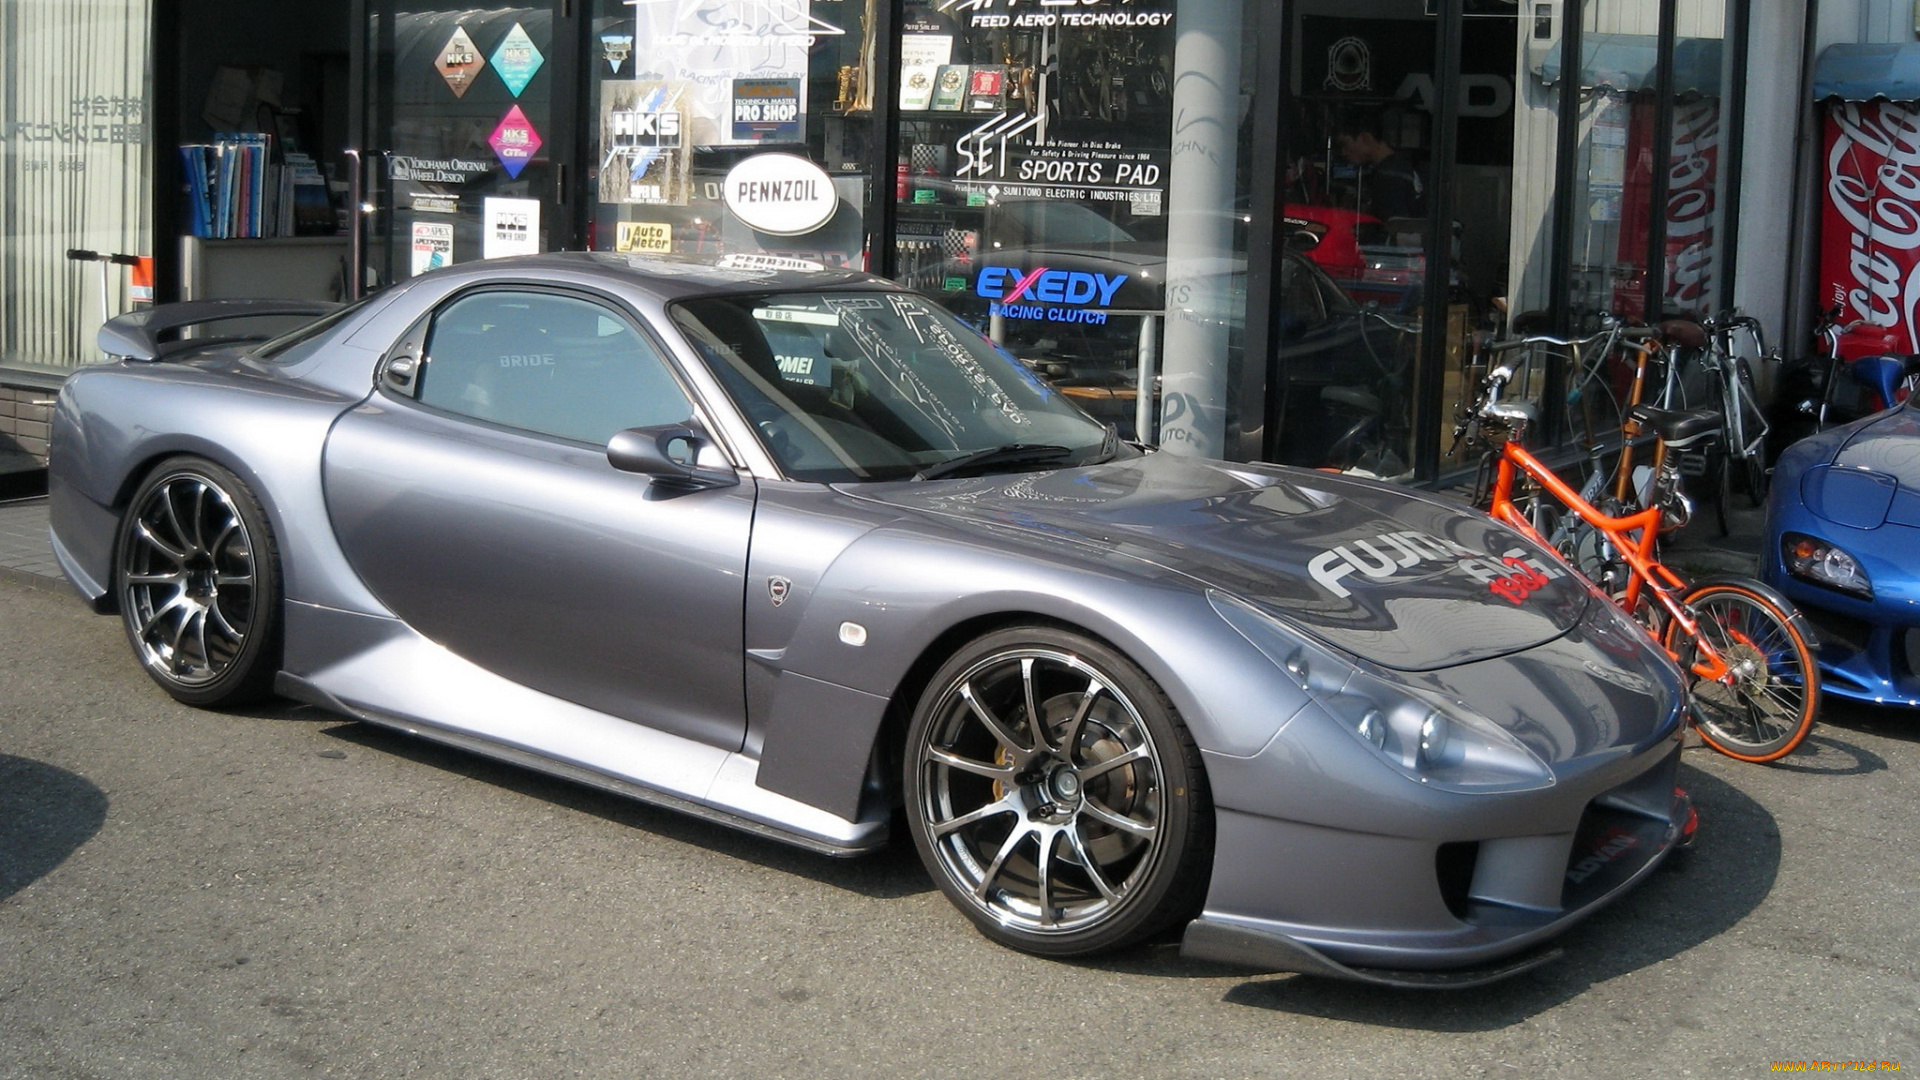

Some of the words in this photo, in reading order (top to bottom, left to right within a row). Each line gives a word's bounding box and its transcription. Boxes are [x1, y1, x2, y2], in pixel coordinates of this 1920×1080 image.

[971, 15, 1010, 27] FEED
[1014, 14, 1057, 26] AERO
[1061, 13, 1173, 26] TECHNOLOGY
[446, 53, 473, 65] HKS
[505, 48, 530, 60] HKS
[735, 105, 760, 121] PRO
[763, 105, 797, 121] SHOP
[613, 112, 681, 137] HKS
[502, 129, 529, 142] HKS
[1030, 149, 1039, 157] for
[1042, 149, 1060, 158] Safety
[1068, 150, 1089, 159] Driving
[1091, 151, 1117, 160] Pleasure
[410, 157, 450, 171] YOKOHAMA
[451, 158, 489, 172] ORIGINAL
[410, 168, 436, 181] WHEEL
[436, 170, 466, 183] DESIGN
[1018, 159, 1102, 183] SPORTS
[1115, 163, 1160, 186] PAD
[738, 180, 818, 203] PENNZOIL
[1003, 187, 1042, 197] SUMITOMO
[1046, 188, 1086, 199] ELECTRIC
[633, 226, 663, 237] Auto
[631, 237, 669, 249] Meter
[976, 266, 1129, 306] EXEDY
[765, 310, 793, 321] 取扱店
[989, 303, 1044, 320] RACING
[1047, 307, 1109, 325] CLUTCH
[499, 353, 556, 368] BRIDE
[774, 354, 814, 375] OMEI
